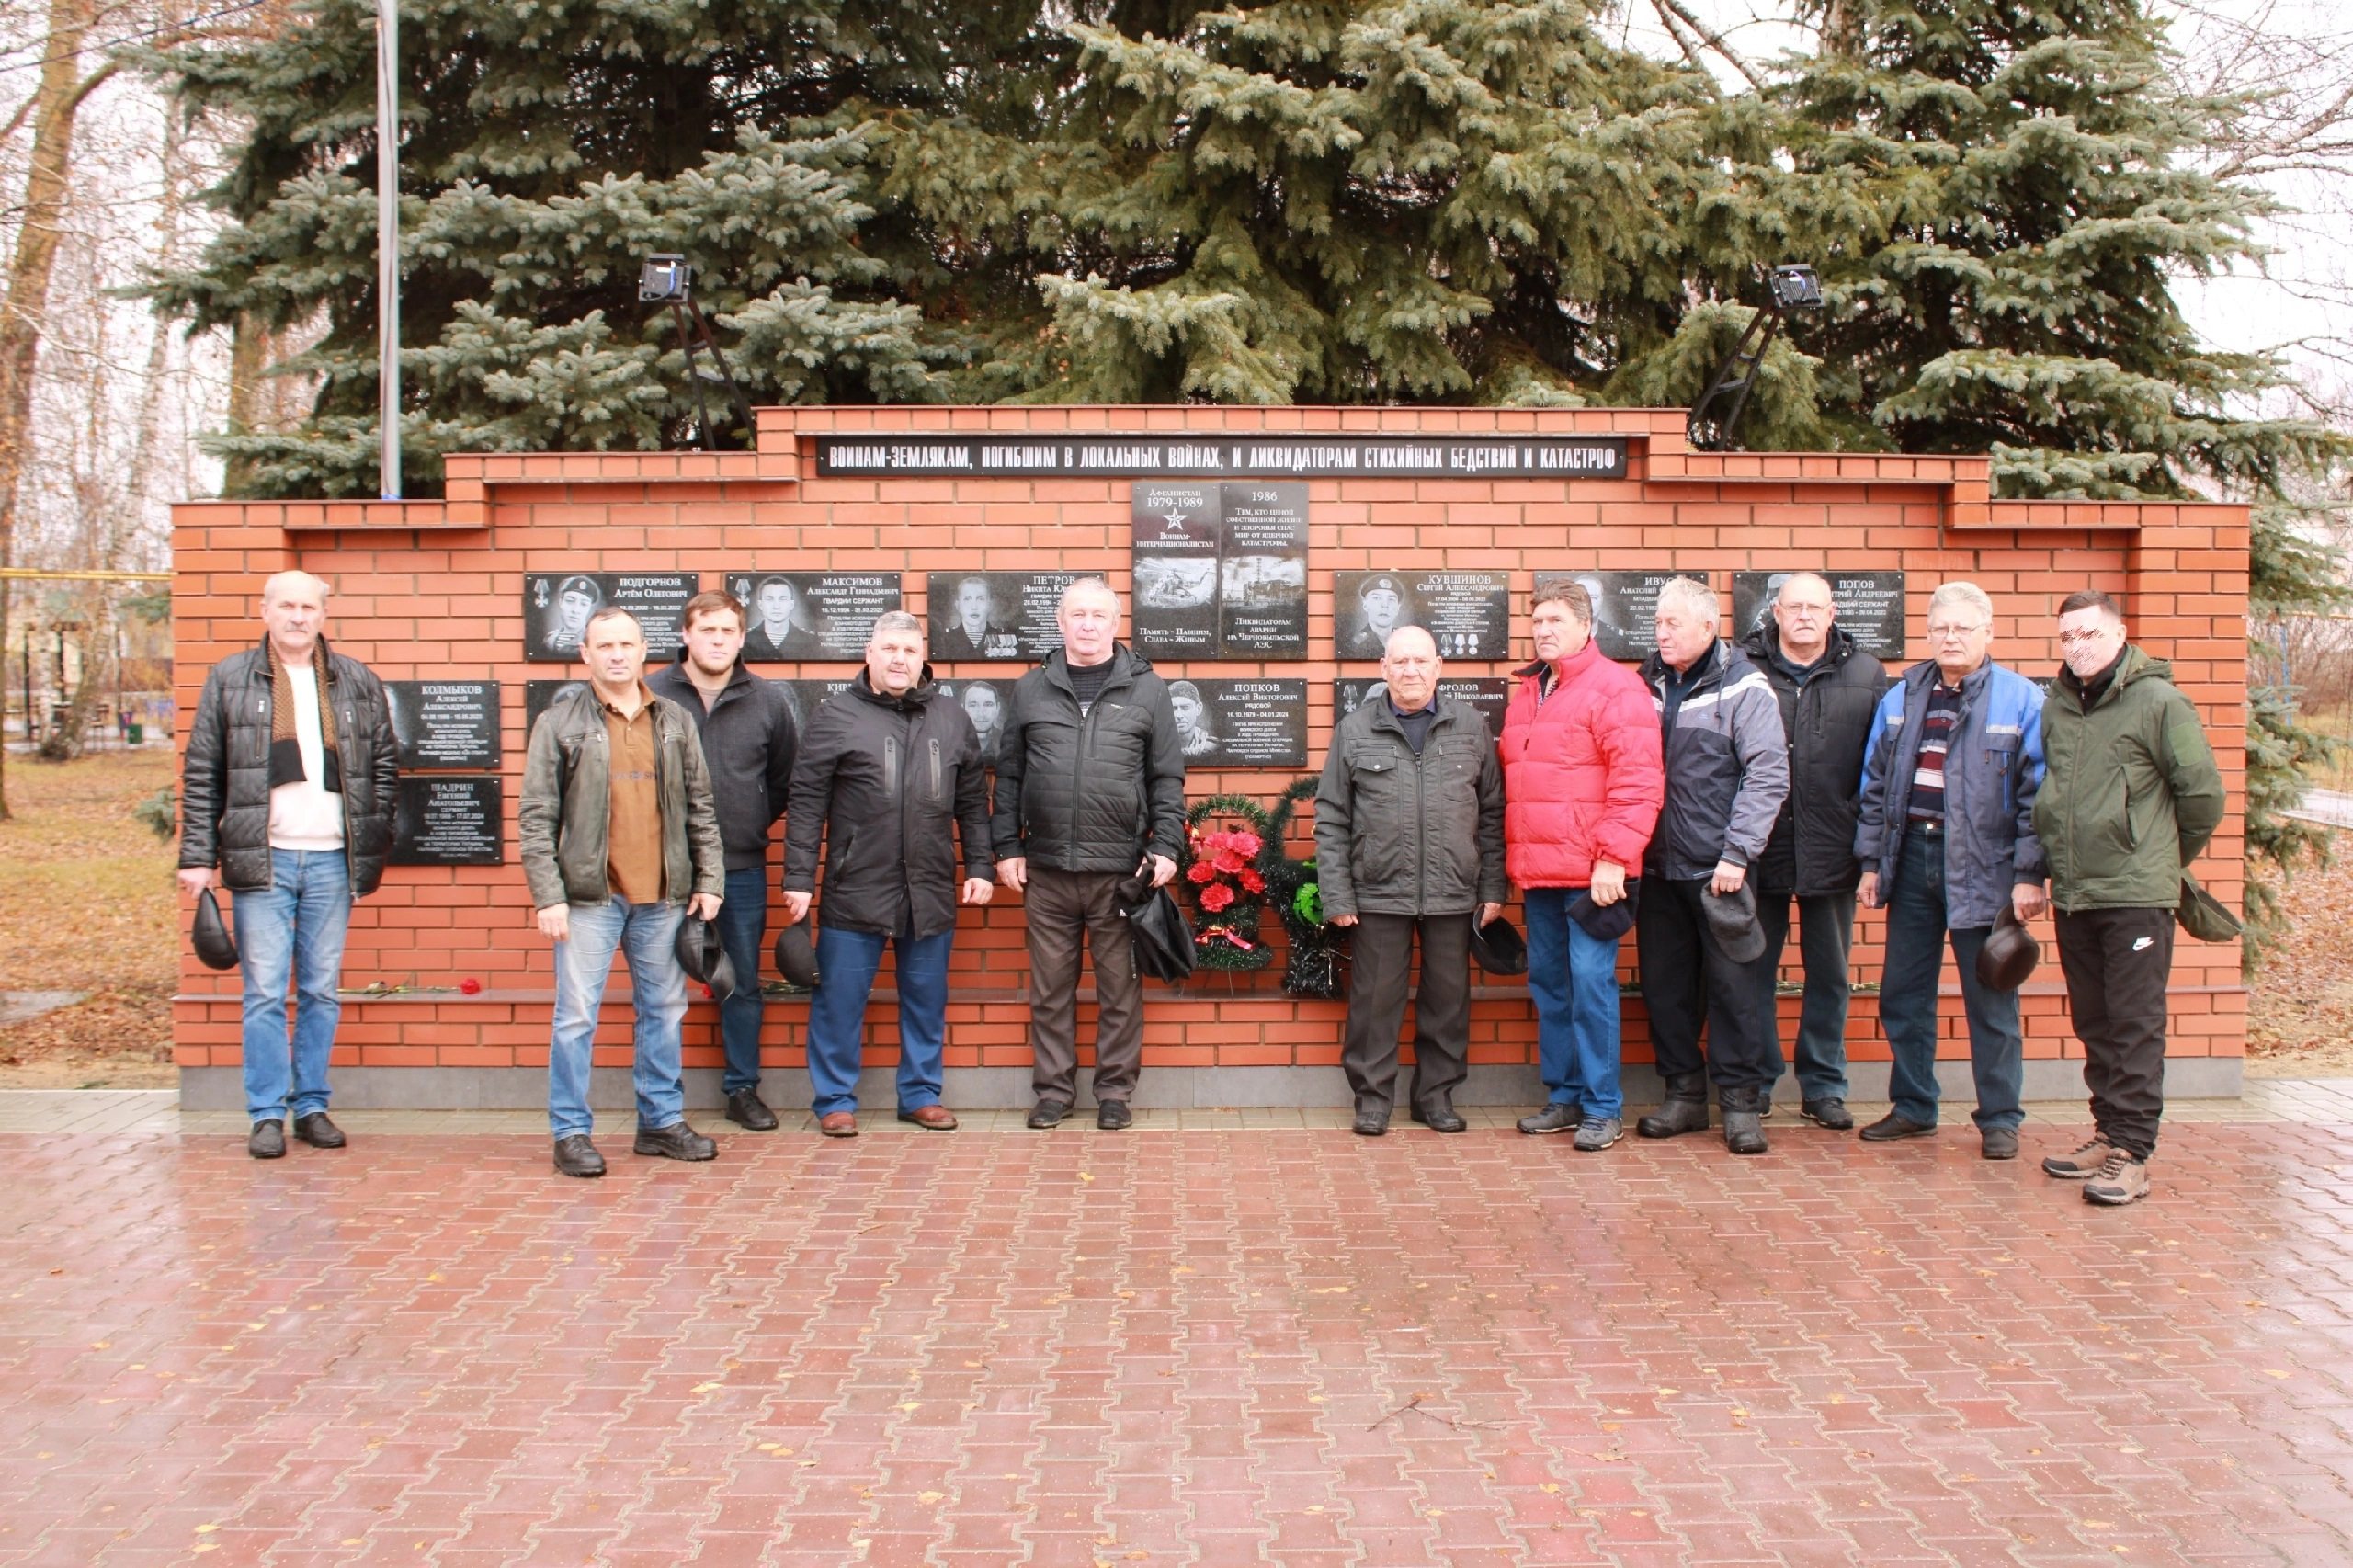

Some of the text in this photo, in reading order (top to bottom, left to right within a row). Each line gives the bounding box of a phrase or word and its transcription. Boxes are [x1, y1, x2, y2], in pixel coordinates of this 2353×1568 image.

[829, 443, 1616, 472] ВОИНАМ-ЗЕМЛЯКАМ, ПОГИБШИМ В ЛОКАЛЬНЫХ ВОЙНАХ, И ЛИКВИДАТОРАМ СТИХИЙНЫХ БЕДСТВИЙ И КАТАСТРОФ
[1251, 491, 1278, 502] 1986
[1146, 497, 1203, 507] 1979-1989
[620, 578, 681, 587] ПОДГОРНОВ
[822, 577, 882, 586] МАКСИМОВ
[1033, 576, 1075, 585] ПЕТРОВ
[1428, 575, 1491, 585] КУВШИНОВ
[1839, 580, 1875, 588] ПОПОВ
[1253, 641, 1273, 649] АЭС
[421, 685, 483, 695] КОЛМЫКОВ
[1234, 684, 1280, 692] ПОПКОВ
[430, 783, 474, 792] ШАДРИН
